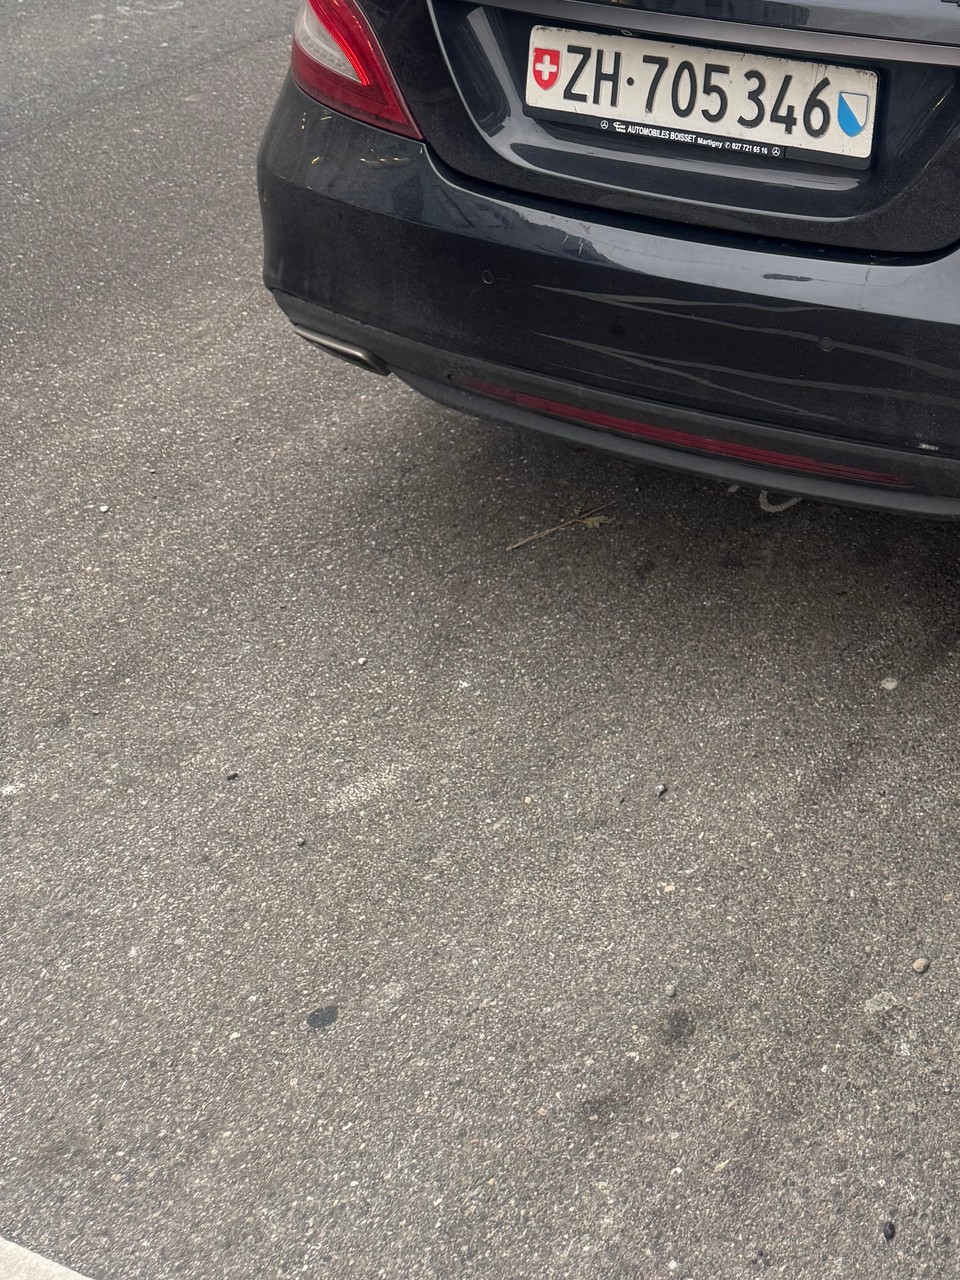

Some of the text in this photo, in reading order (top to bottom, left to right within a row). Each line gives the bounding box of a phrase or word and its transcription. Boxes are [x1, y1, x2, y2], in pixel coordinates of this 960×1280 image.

[627, 125, 669, 140] AUTOMOBILES
[670, 132, 697, 144] BOISSET
[697, 137, 723, 149] Martigny
[742, 144, 752, 152] 721
